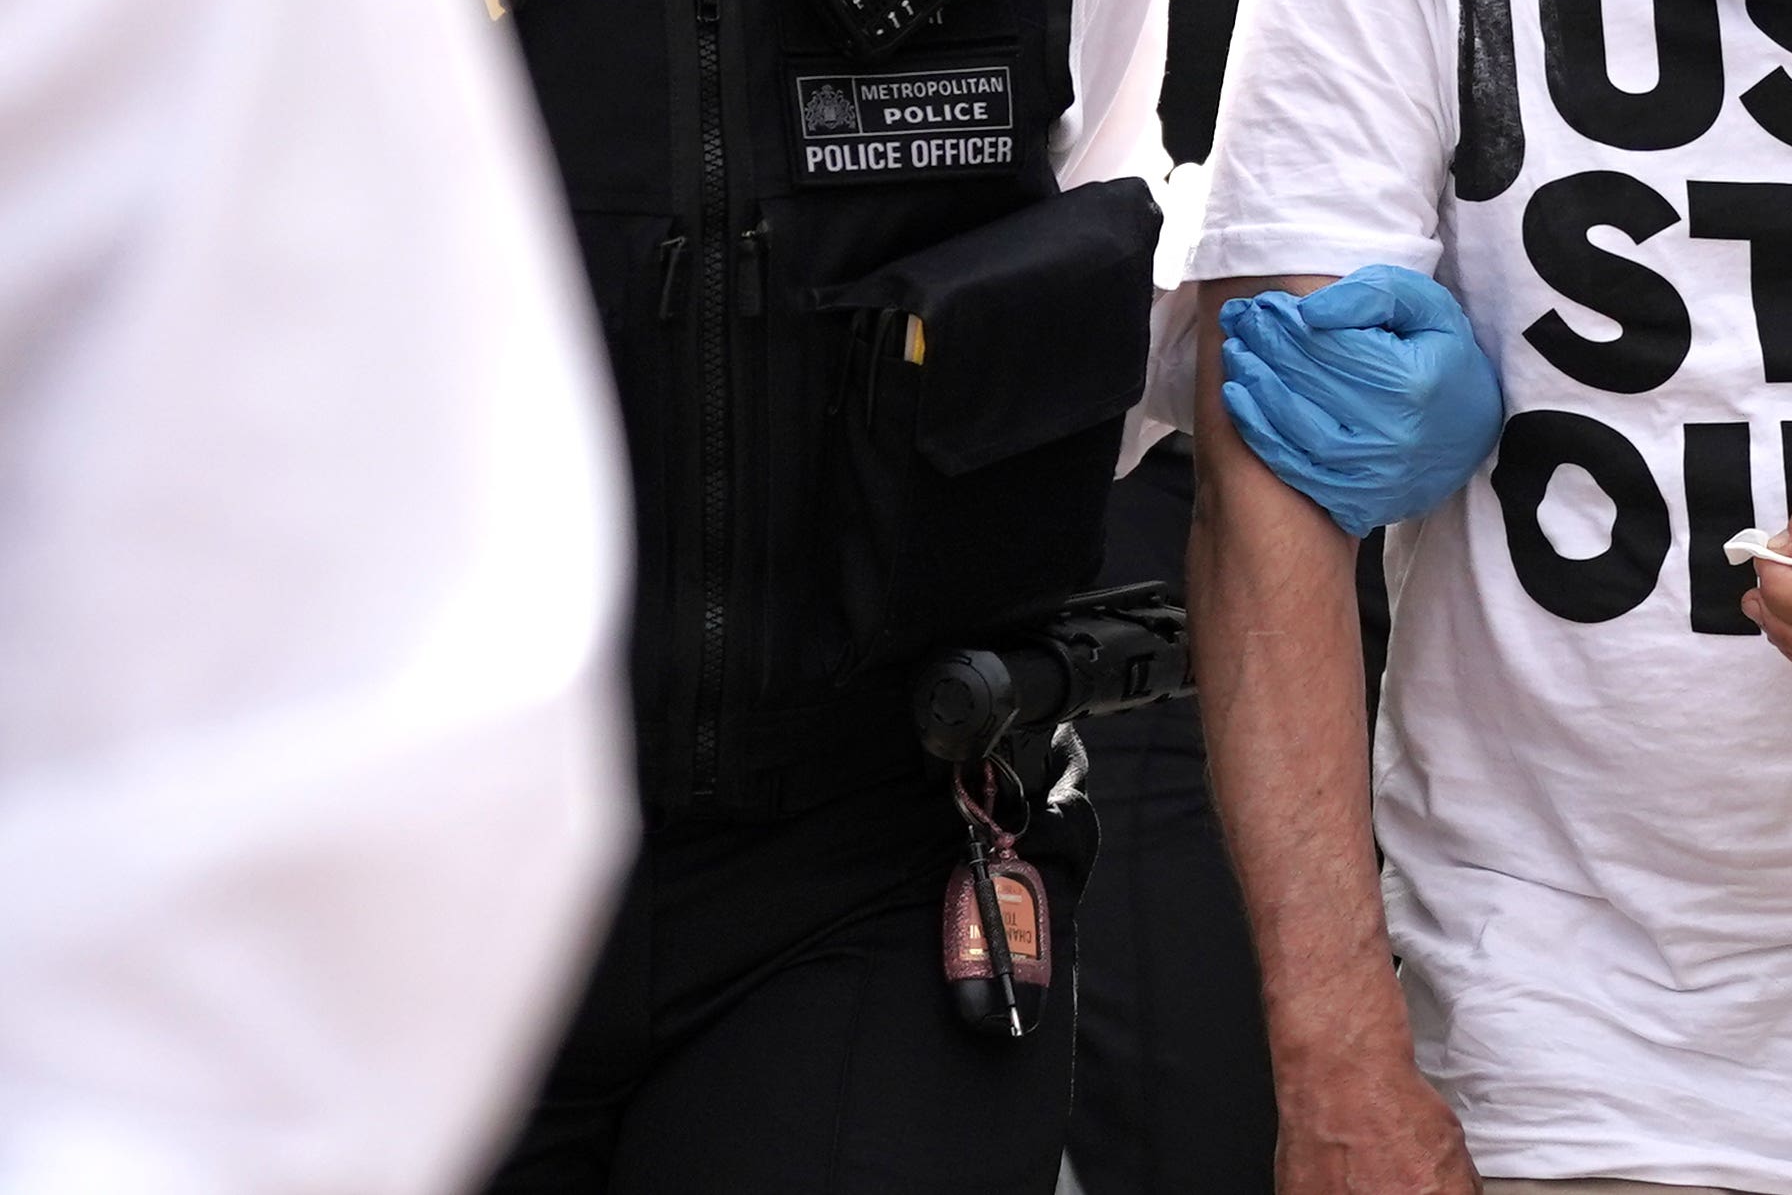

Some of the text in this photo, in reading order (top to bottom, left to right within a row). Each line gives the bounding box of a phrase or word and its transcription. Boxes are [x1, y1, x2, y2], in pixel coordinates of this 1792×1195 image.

[861, 77, 1004, 101] METROPOLITAN
[883, 102, 989, 124] POLICE
[806, 137, 1012, 172] POLICE OFFICER
